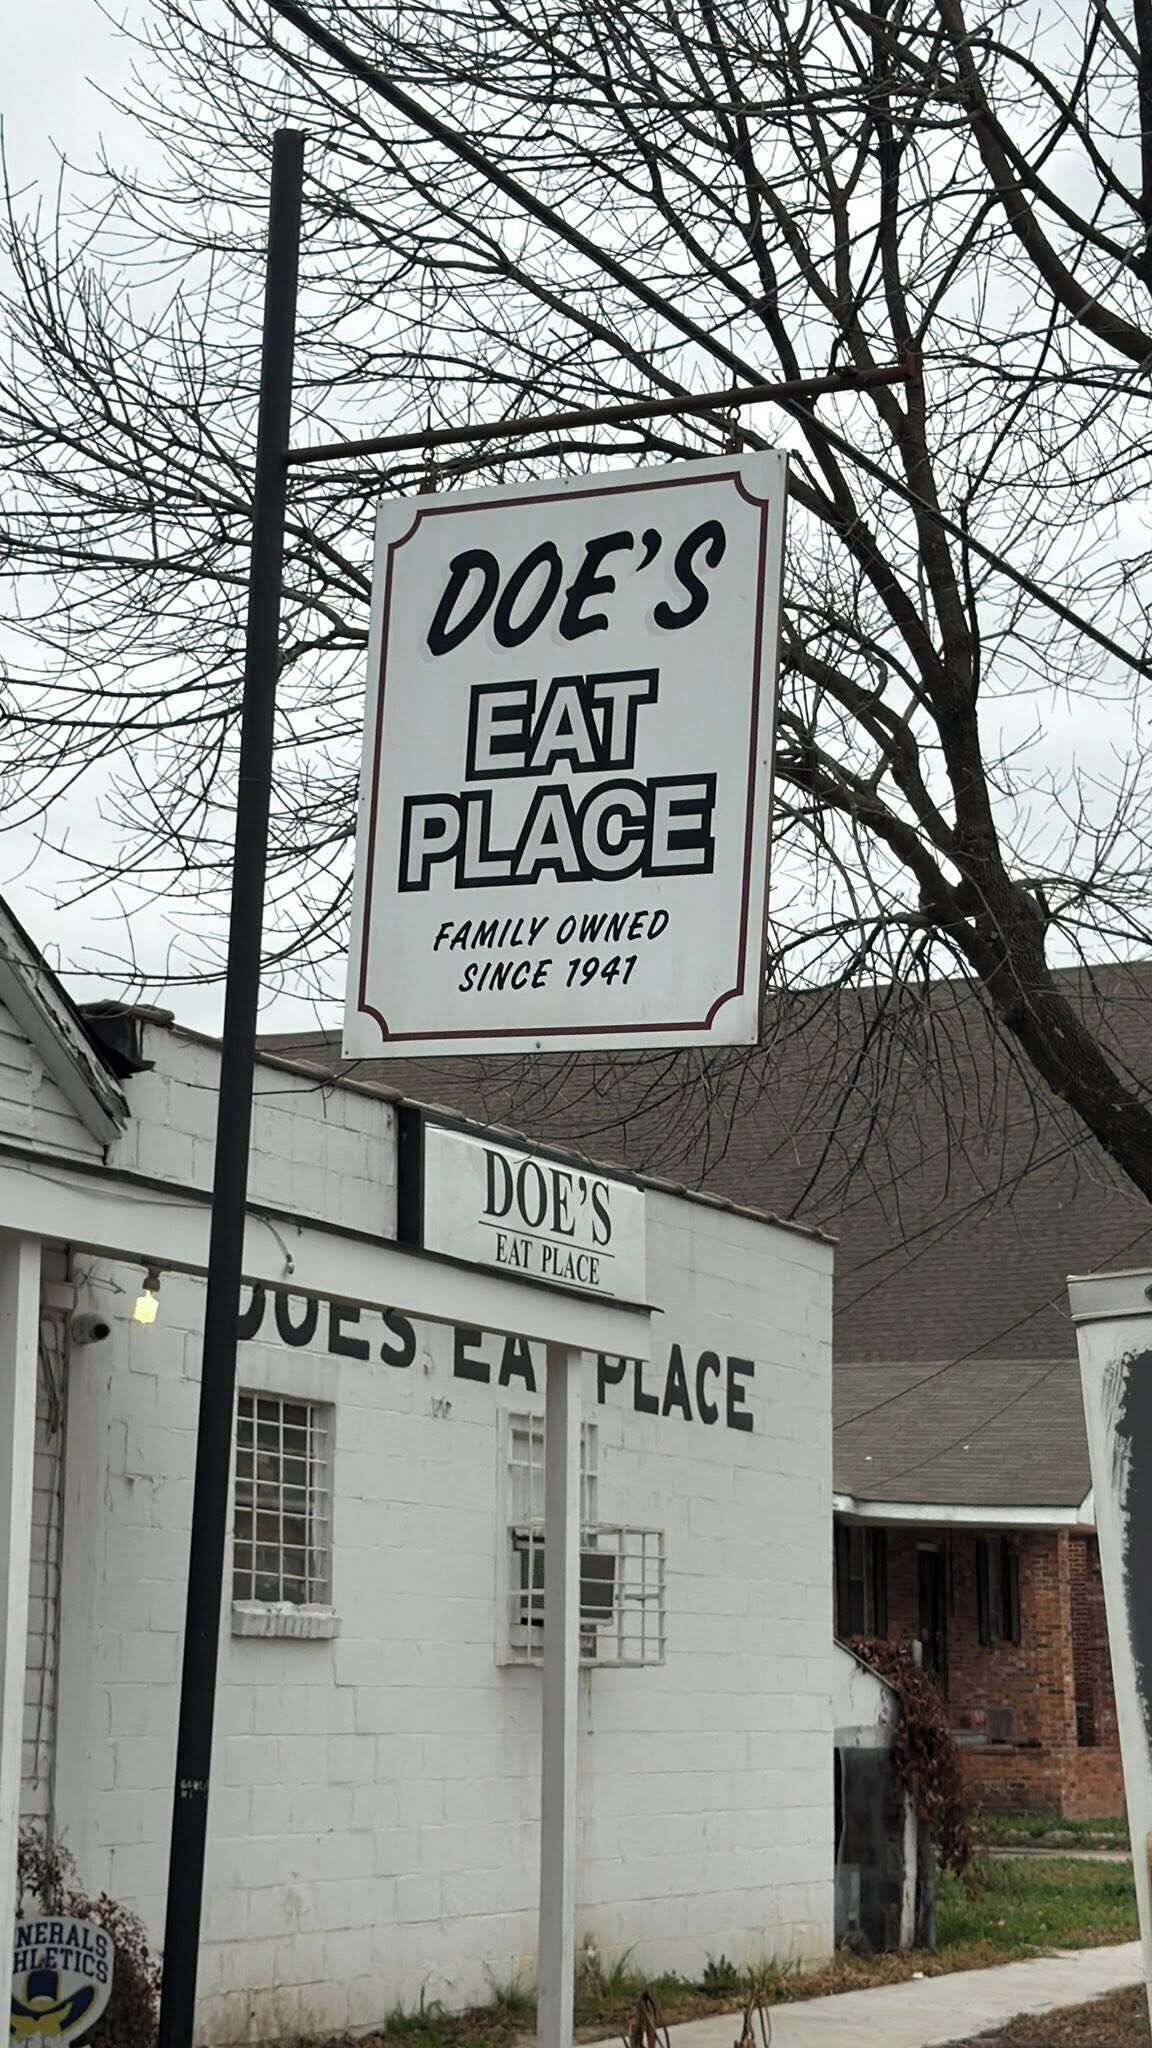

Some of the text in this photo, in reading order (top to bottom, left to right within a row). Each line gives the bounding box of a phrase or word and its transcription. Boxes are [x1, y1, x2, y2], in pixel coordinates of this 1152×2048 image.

[426, 520, 726, 656] DOE'S
[465, 668, 659, 781] EAT
[398, 772, 717, 893] PLACE
[433, 909, 669, 951] FAMILY OWNED
[458, 954, 638, 992] SINCE 1941
[482, 1147, 612, 1246] DOE'S
[496, 1233, 600, 1285] EAT PLACE
[453, 1326, 537, 1393] EA
[597, 1343, 755, 1433] PLACE
[13, 1947, 109, 1984] HLETICS
[16, 1922, 107, 1959] NERALS
